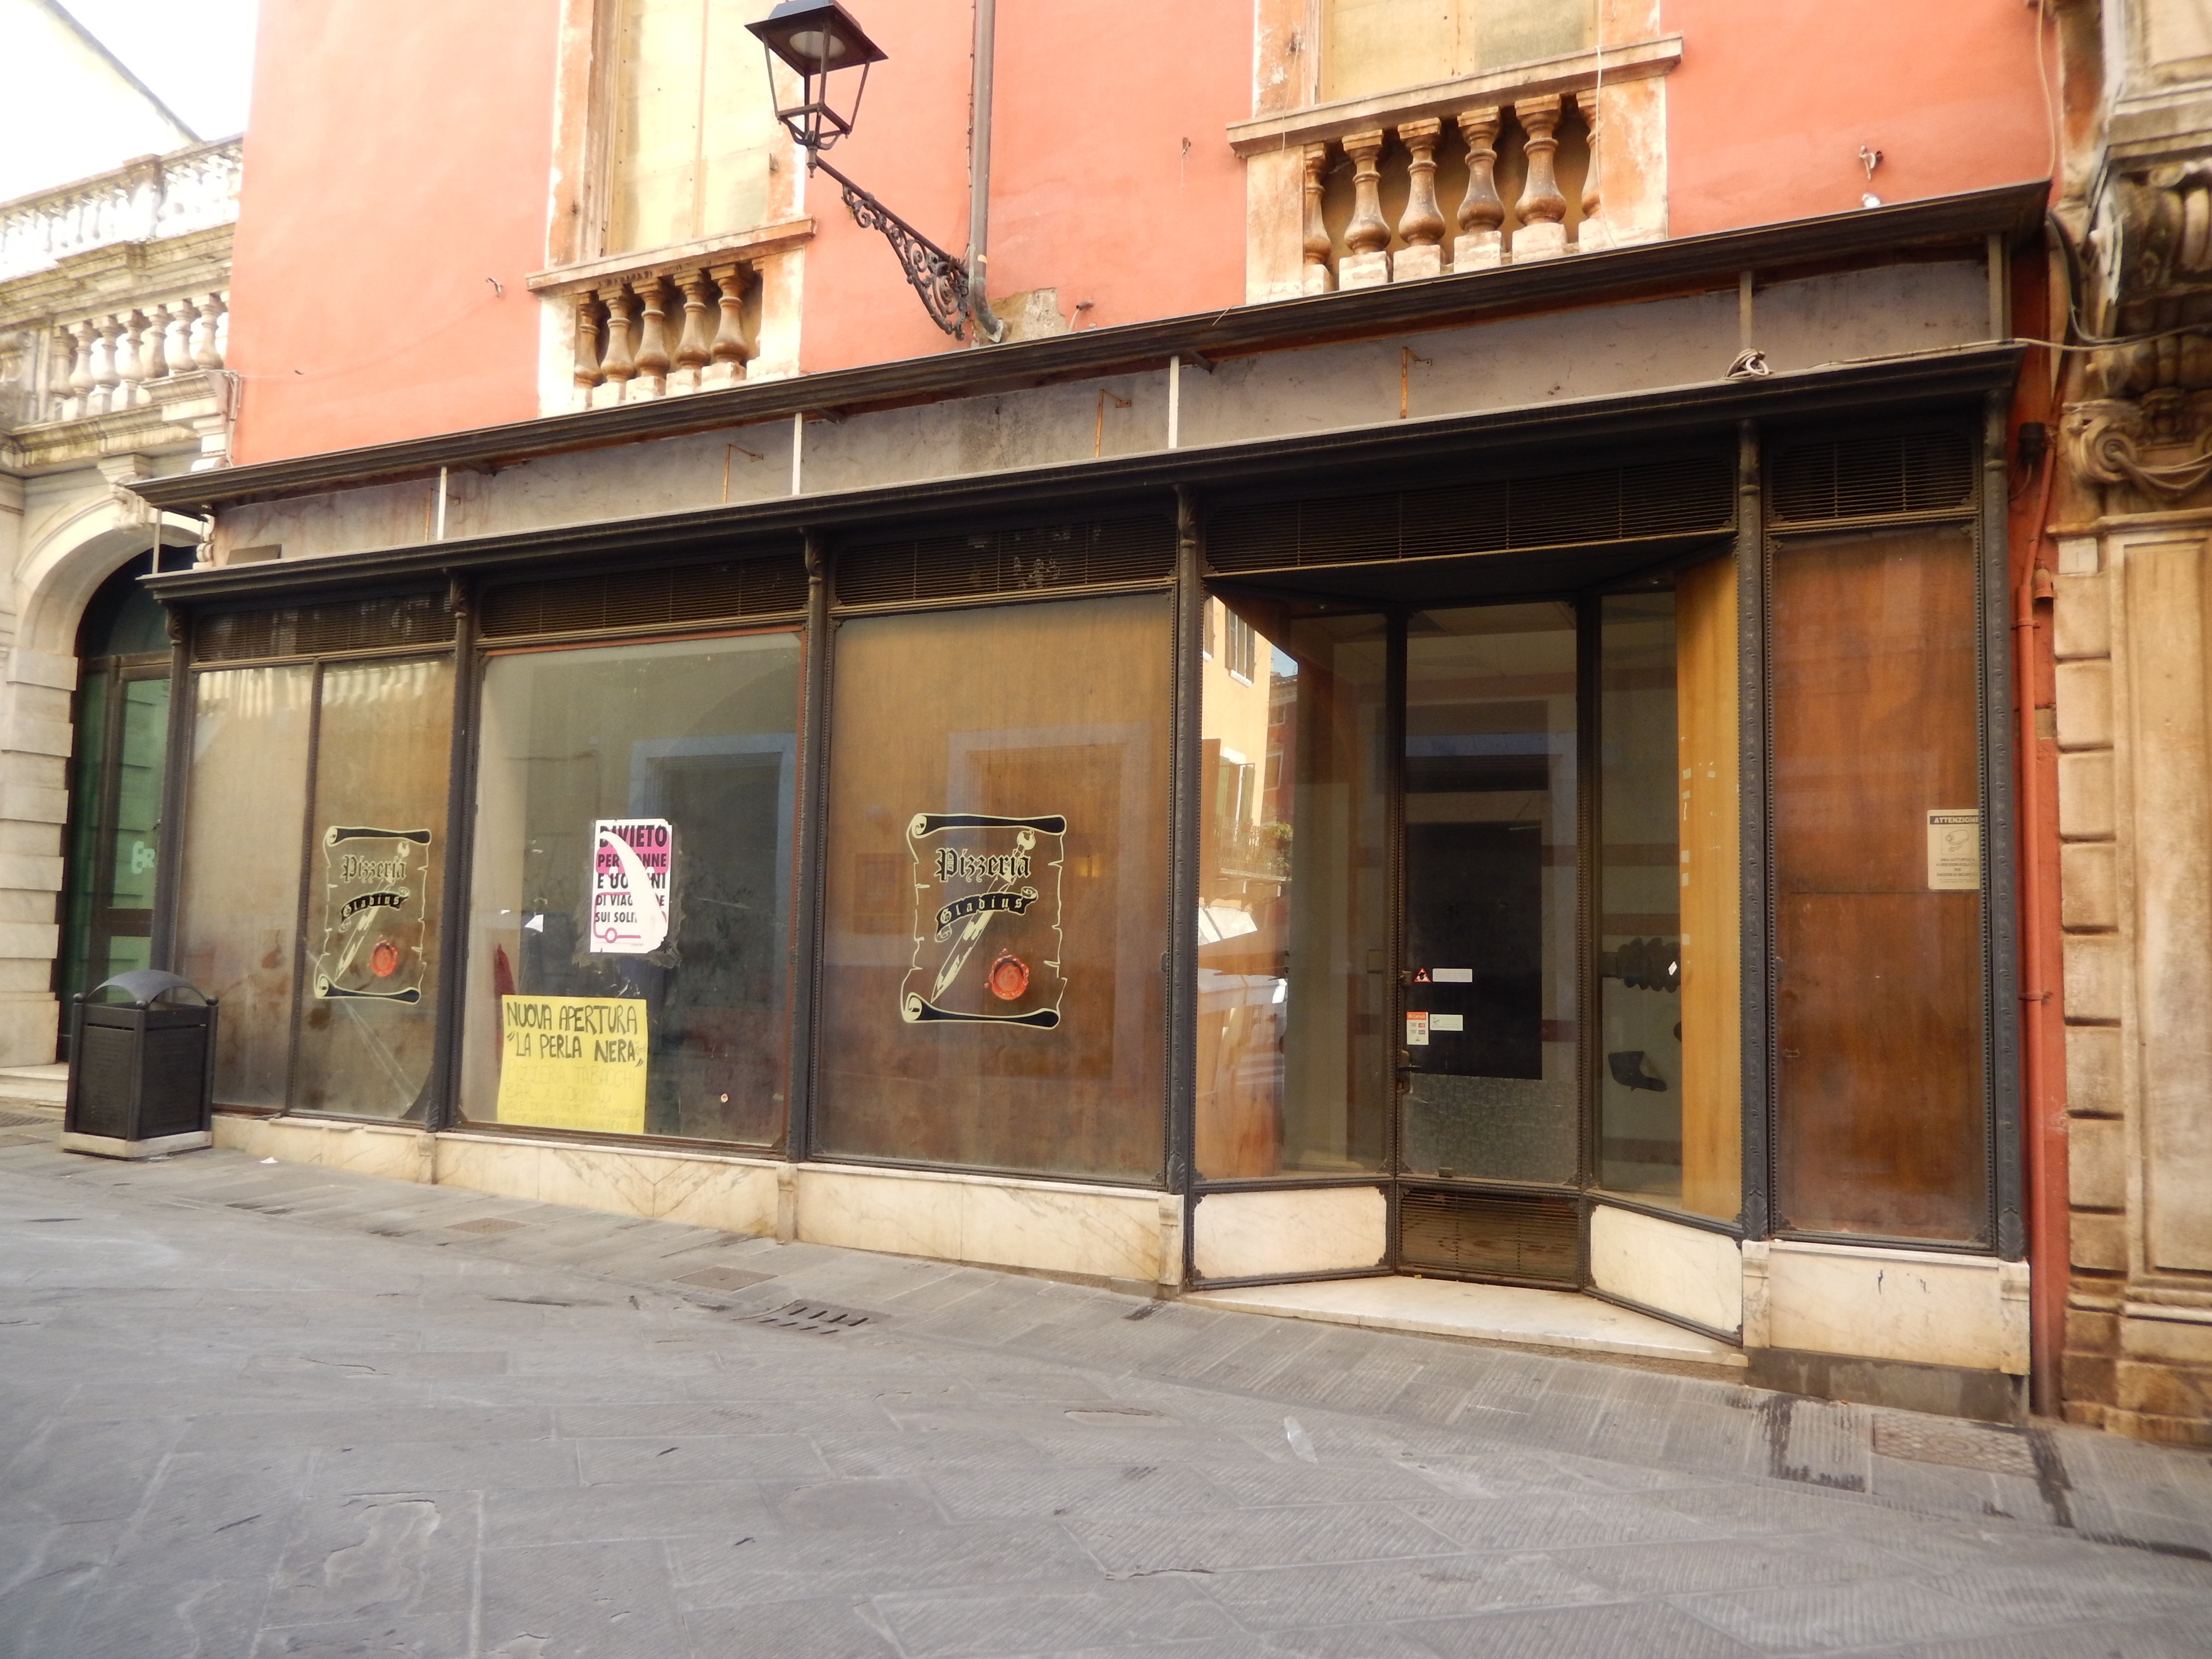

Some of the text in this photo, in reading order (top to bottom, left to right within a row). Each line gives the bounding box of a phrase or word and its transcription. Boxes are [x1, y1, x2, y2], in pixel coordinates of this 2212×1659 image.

[340, 854, 407, 883] Pizzeria
[598, 854, 620, 867] PER
[934, 847, 1032, 883] Pizzeria
[597, 872, 666, 889] E UONI
[343, 894, 399, 917] Gladius
[595, 894, 606, 906] DI
[939, 895, 1023, 924] Gladius
[595, 912, 637, 923] SUI SOLI
[506, 1001, 638, 1035] NUOVA APERTURA
[540, 1034, 582, 1059] PERLA
[572, 1065, 635, 1091] TABACCHI
[505, 1082, 536, 1099] BAR
